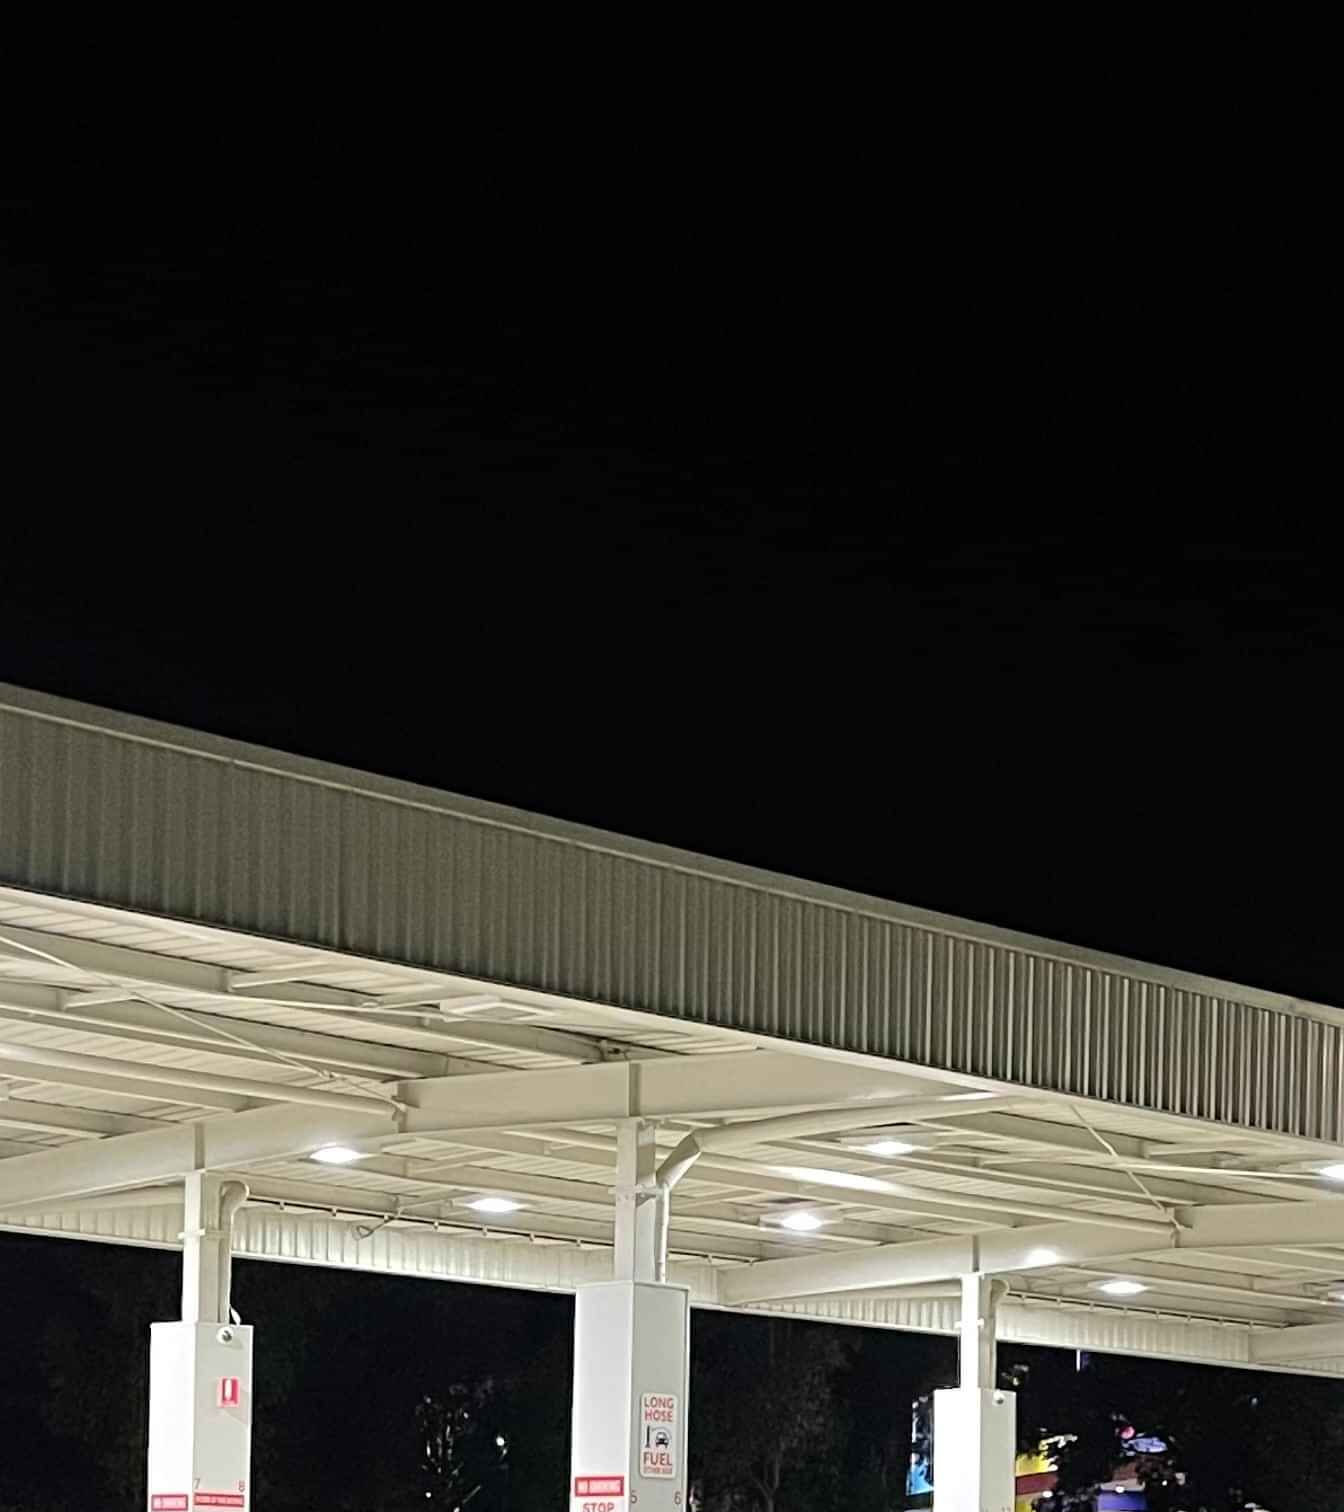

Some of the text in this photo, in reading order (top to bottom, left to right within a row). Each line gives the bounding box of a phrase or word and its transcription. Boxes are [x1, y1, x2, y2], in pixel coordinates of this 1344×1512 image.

[644, 1396, 674, 1409] LONG
[645, 1408, 673, 1422] HOSE
[644, 1452, 673, 1466] FUEL
[194, 1478, 201, 1489] 7
[630, 1491, 638, 1504] 5
[674, 1491, 681, 1505] 6
